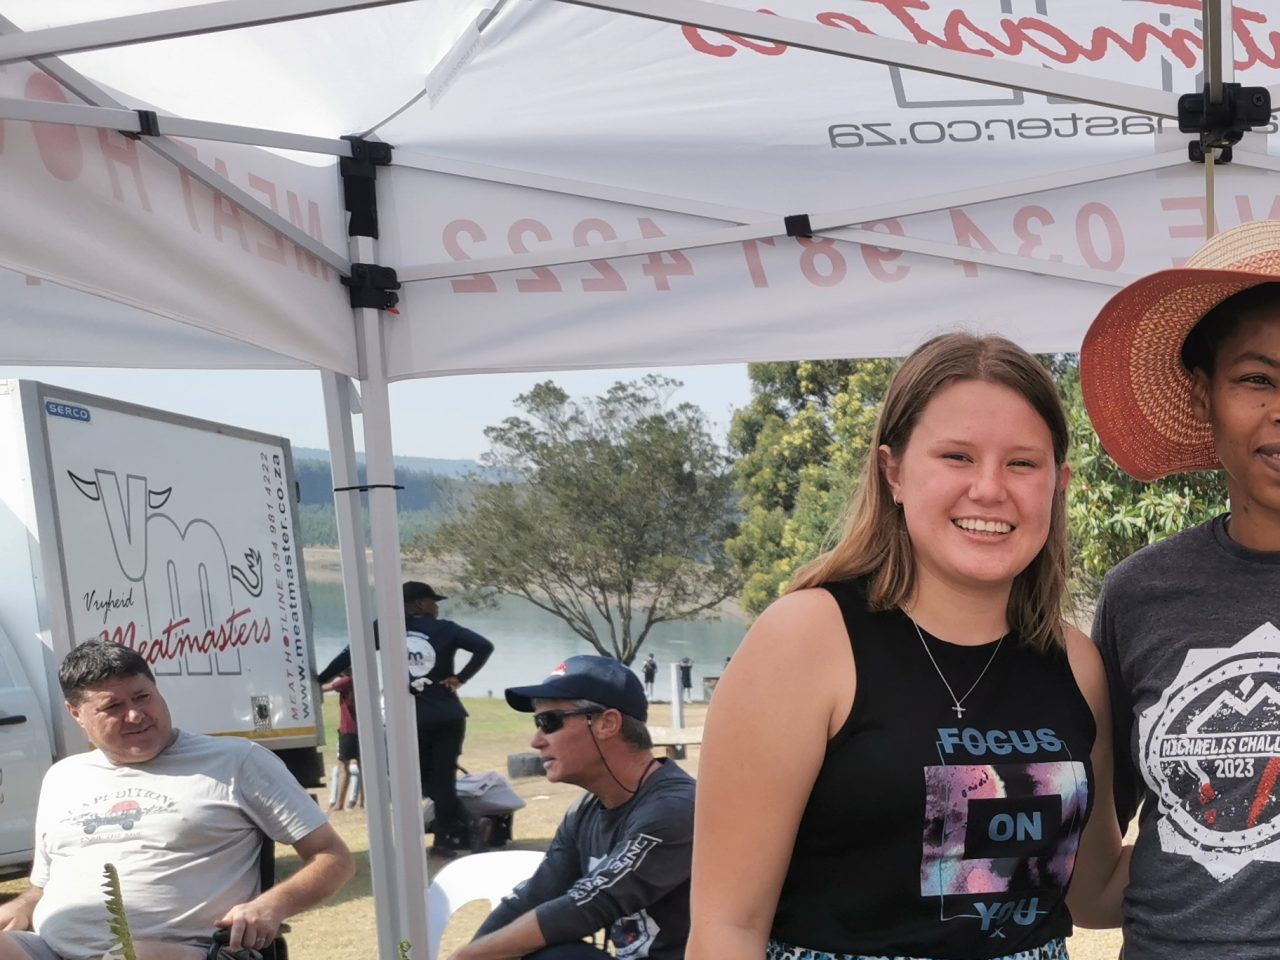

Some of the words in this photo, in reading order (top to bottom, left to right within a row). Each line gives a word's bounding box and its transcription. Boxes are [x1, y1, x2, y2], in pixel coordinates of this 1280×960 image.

[48, 402, 91, 420] SERCO
[259, 451, 273, 497] 4222
[271, 453, 310, 720] www.meatmaster.co.za
[275, 578, 294, 665] HOTLINE
[98, 607, 272, 668] Meatmasters
[936, 727, 1063, 755] FOCUS
[1162, 737, 1237, 757] MICHAELIS
[1215, 758, 1255, 778] 2023
[988, 811, 1043, 841] ON
